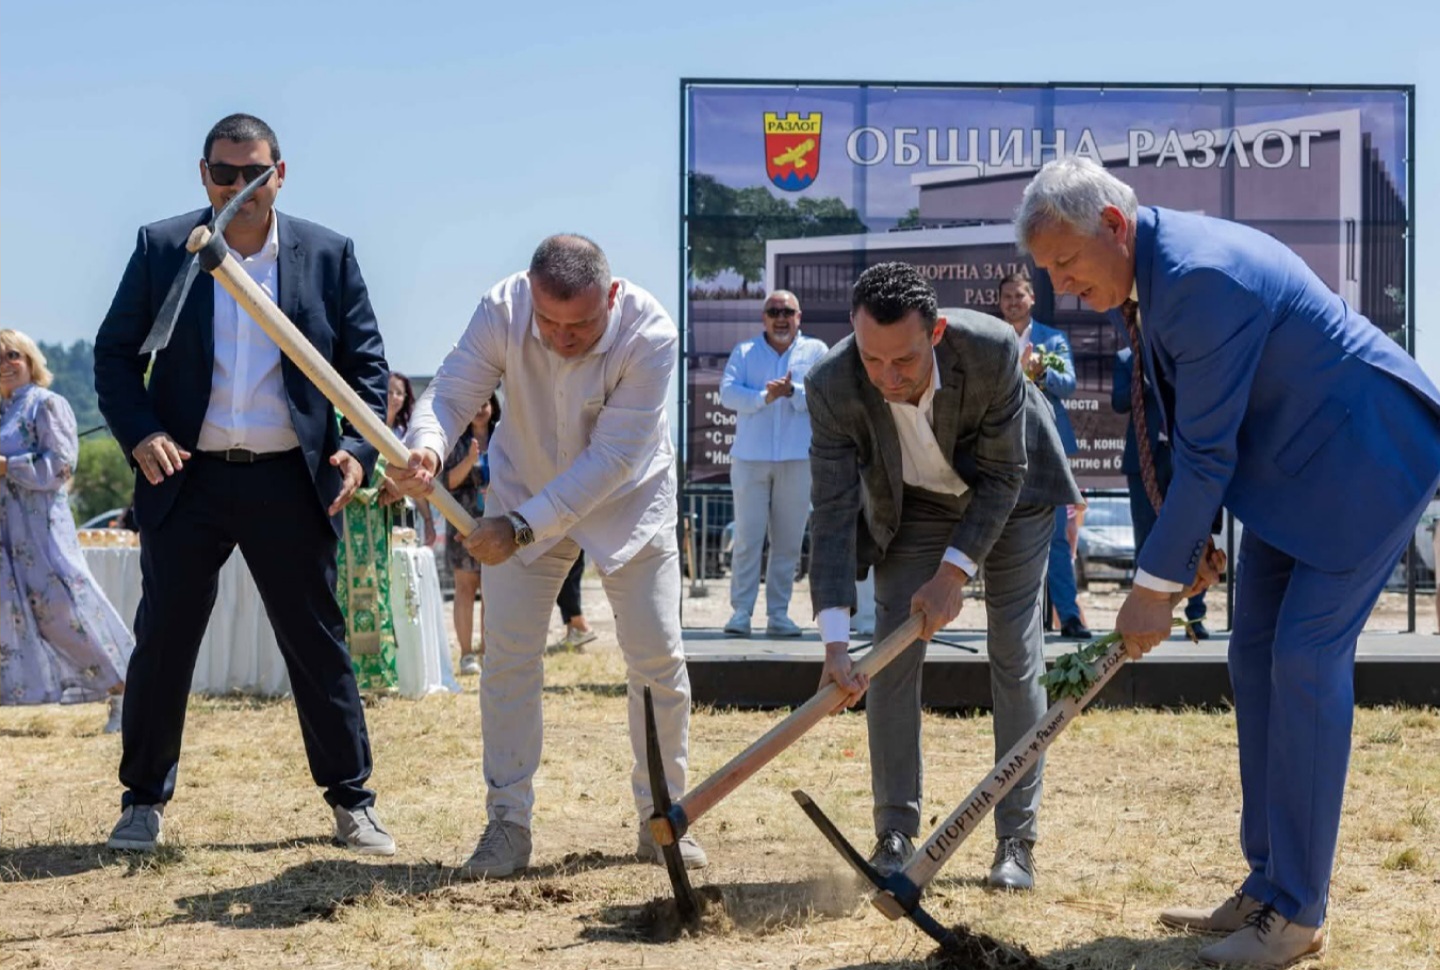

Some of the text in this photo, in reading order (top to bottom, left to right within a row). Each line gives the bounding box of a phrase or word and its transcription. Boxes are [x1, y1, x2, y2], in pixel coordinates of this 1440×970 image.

[767, 121, 818, 132] РАЗЛОГ
[846, 126, 1322, 177] ОБЩИНА РАЗЛОГ
[917, 264, 979, 280] ПОРТНА
[964, 288, 1000, 305] РАЗ
[926, 790, 994, 862] СПОРТНА
